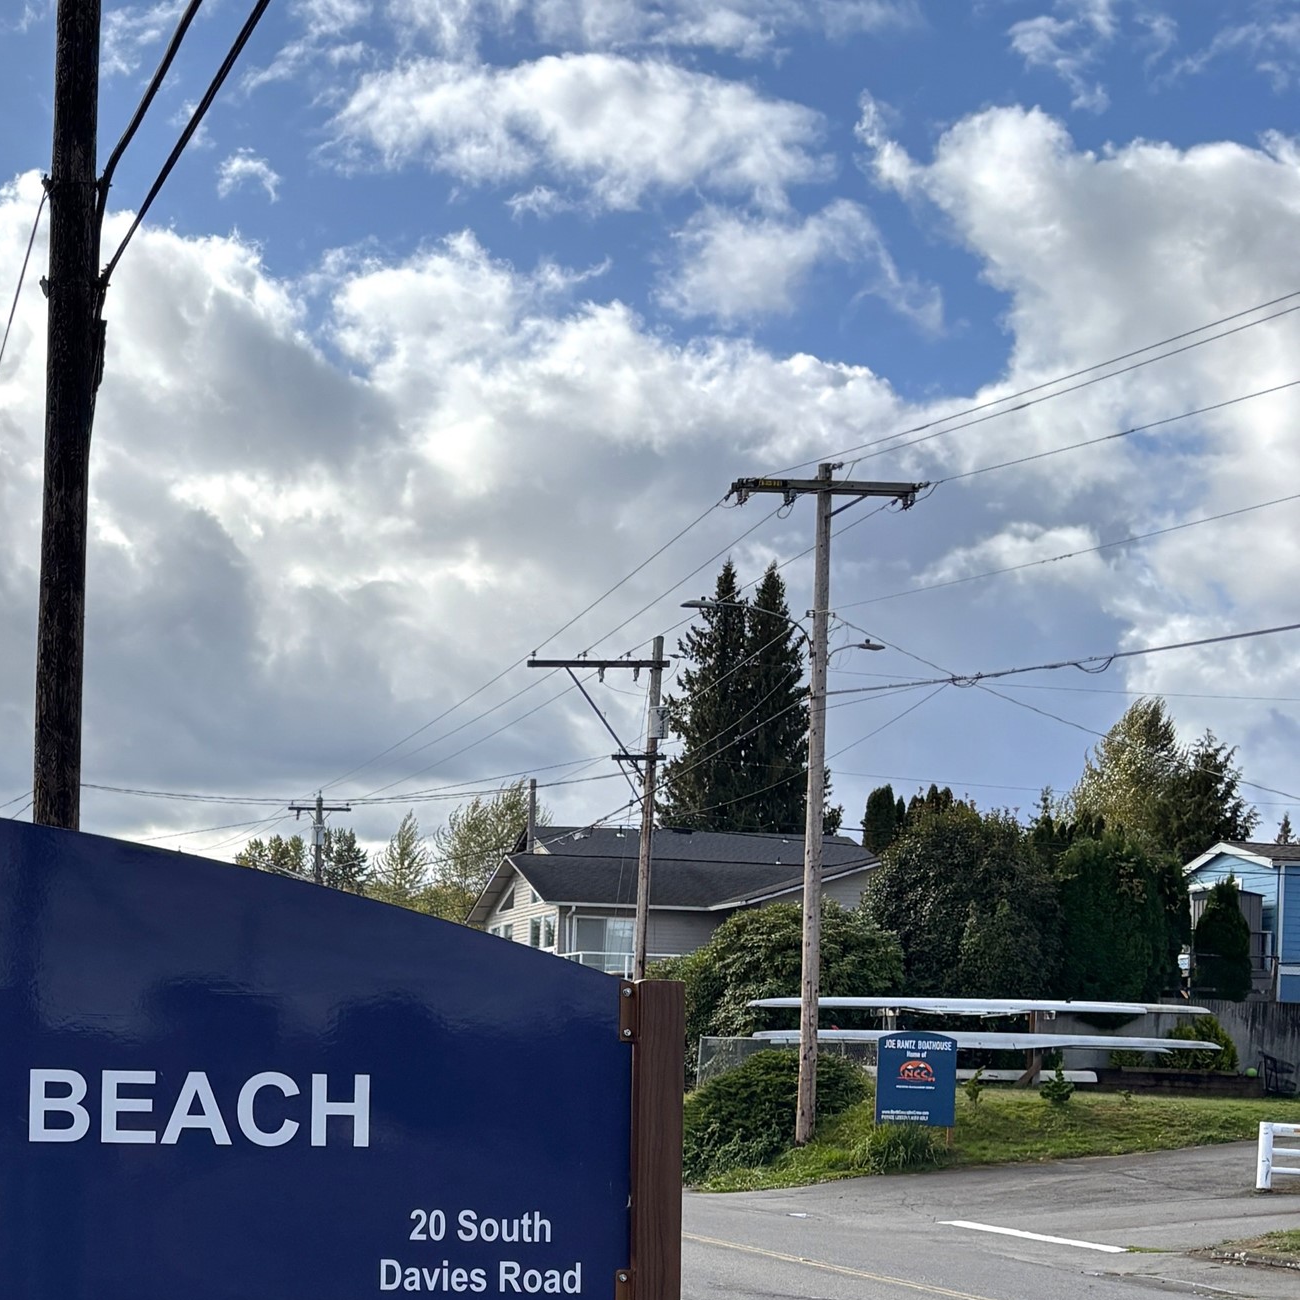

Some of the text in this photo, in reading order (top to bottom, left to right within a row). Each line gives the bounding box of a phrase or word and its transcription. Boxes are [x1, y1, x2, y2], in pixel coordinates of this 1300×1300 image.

[885, 1040, 952, 1051] JOE RANTZ BOATHOUSE
[904, 1069, 927, 1079] NCC
[29, 1069, 370, 1147] BEACH
[410, 1209, 551, 1242] 20 South
[380, 1259, 581, 1293] Davies Road
